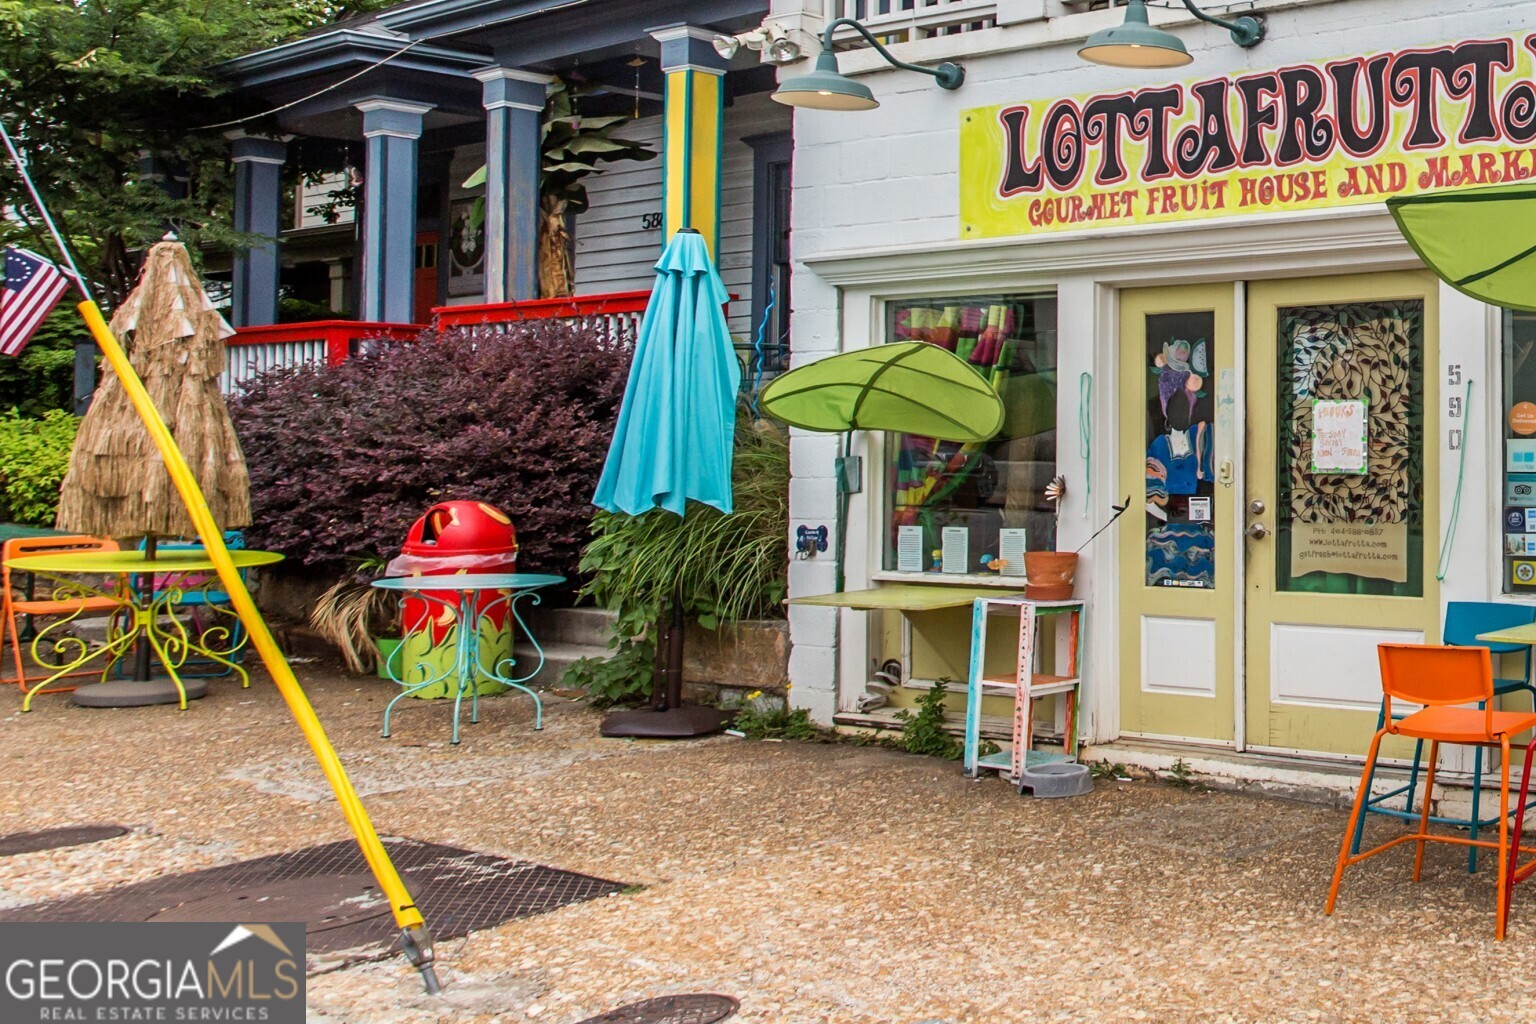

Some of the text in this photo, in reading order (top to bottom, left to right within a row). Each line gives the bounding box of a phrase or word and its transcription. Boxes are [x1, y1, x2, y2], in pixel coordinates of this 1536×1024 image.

[1028, 188, 1139, 228] GOURMET
[1239, 171, 1328, 206] HOUSE
[1337, 163, 1408, 198] AND
[642, 212, 664, 230] 58
[1309, 538, 1388, 549] www.lottafrutta.com
